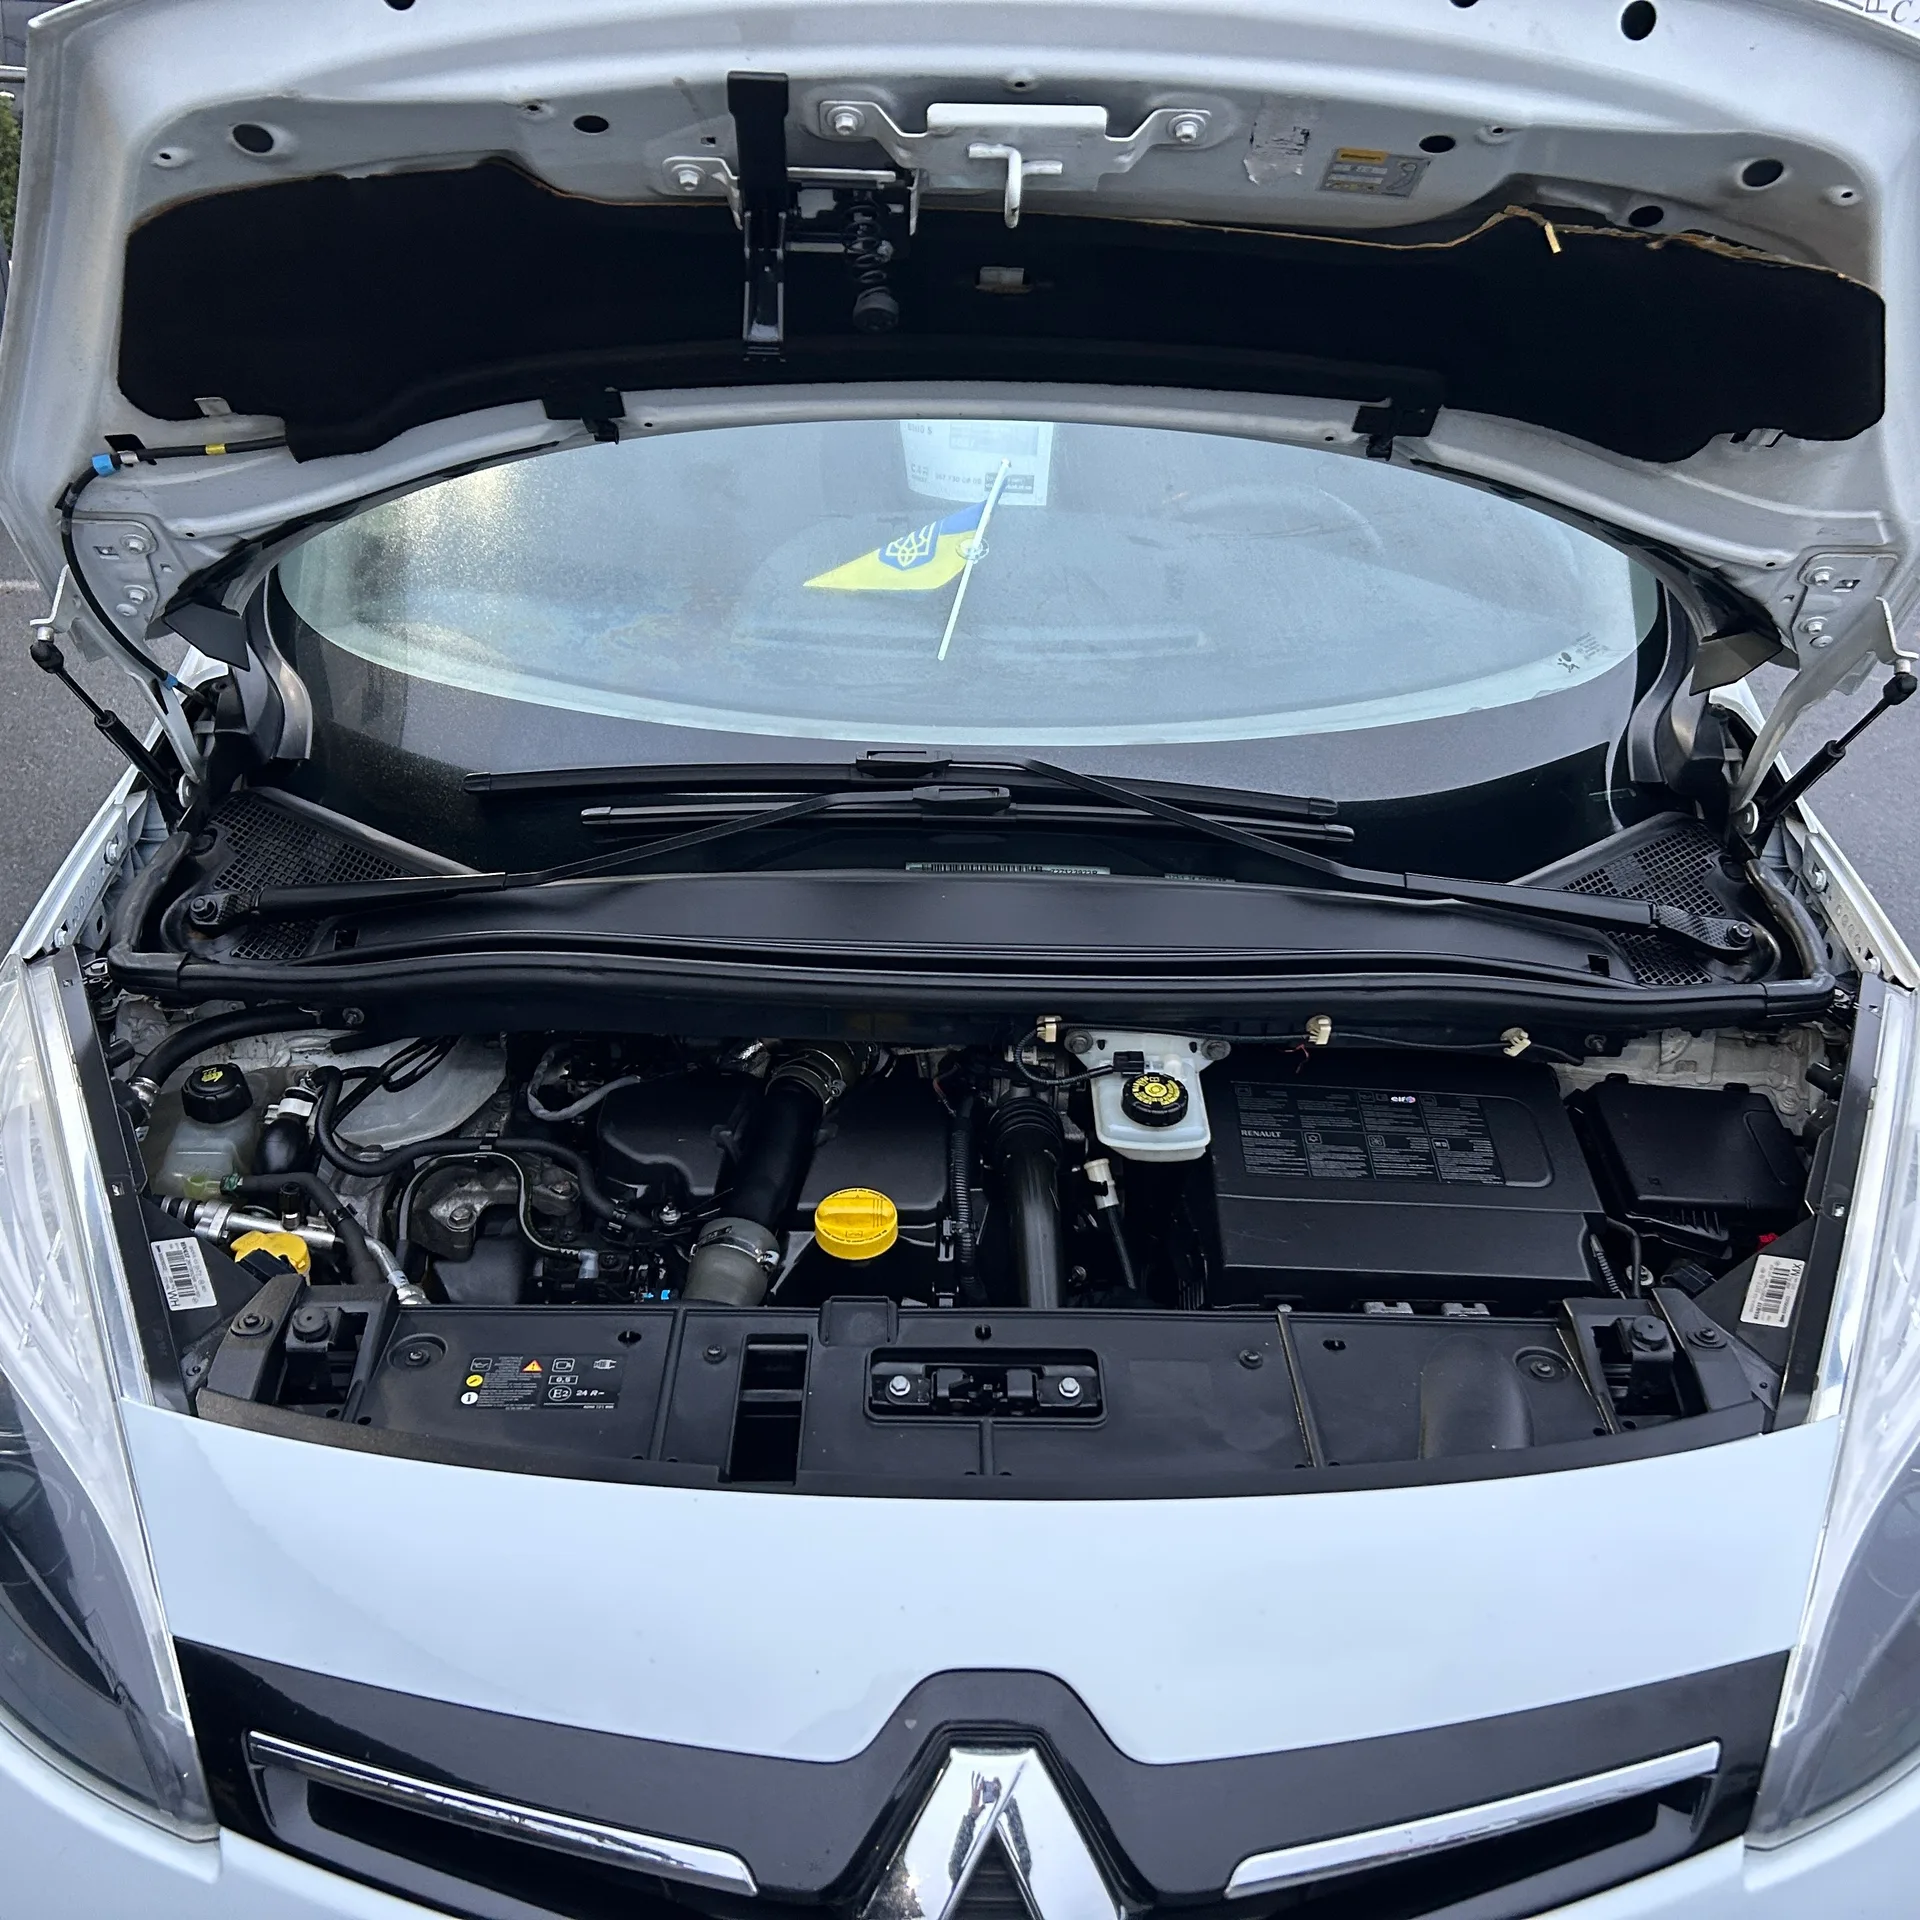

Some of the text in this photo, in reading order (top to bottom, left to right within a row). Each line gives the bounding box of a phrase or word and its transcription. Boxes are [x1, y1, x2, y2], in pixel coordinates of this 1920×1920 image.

[1240, 1129, 1282, 1138] RENAULT
[1791, 1263, 1803, 1276] MX
[167, 1290, 181, 1307] WH
[552, 1388, 569, 1399] E2
